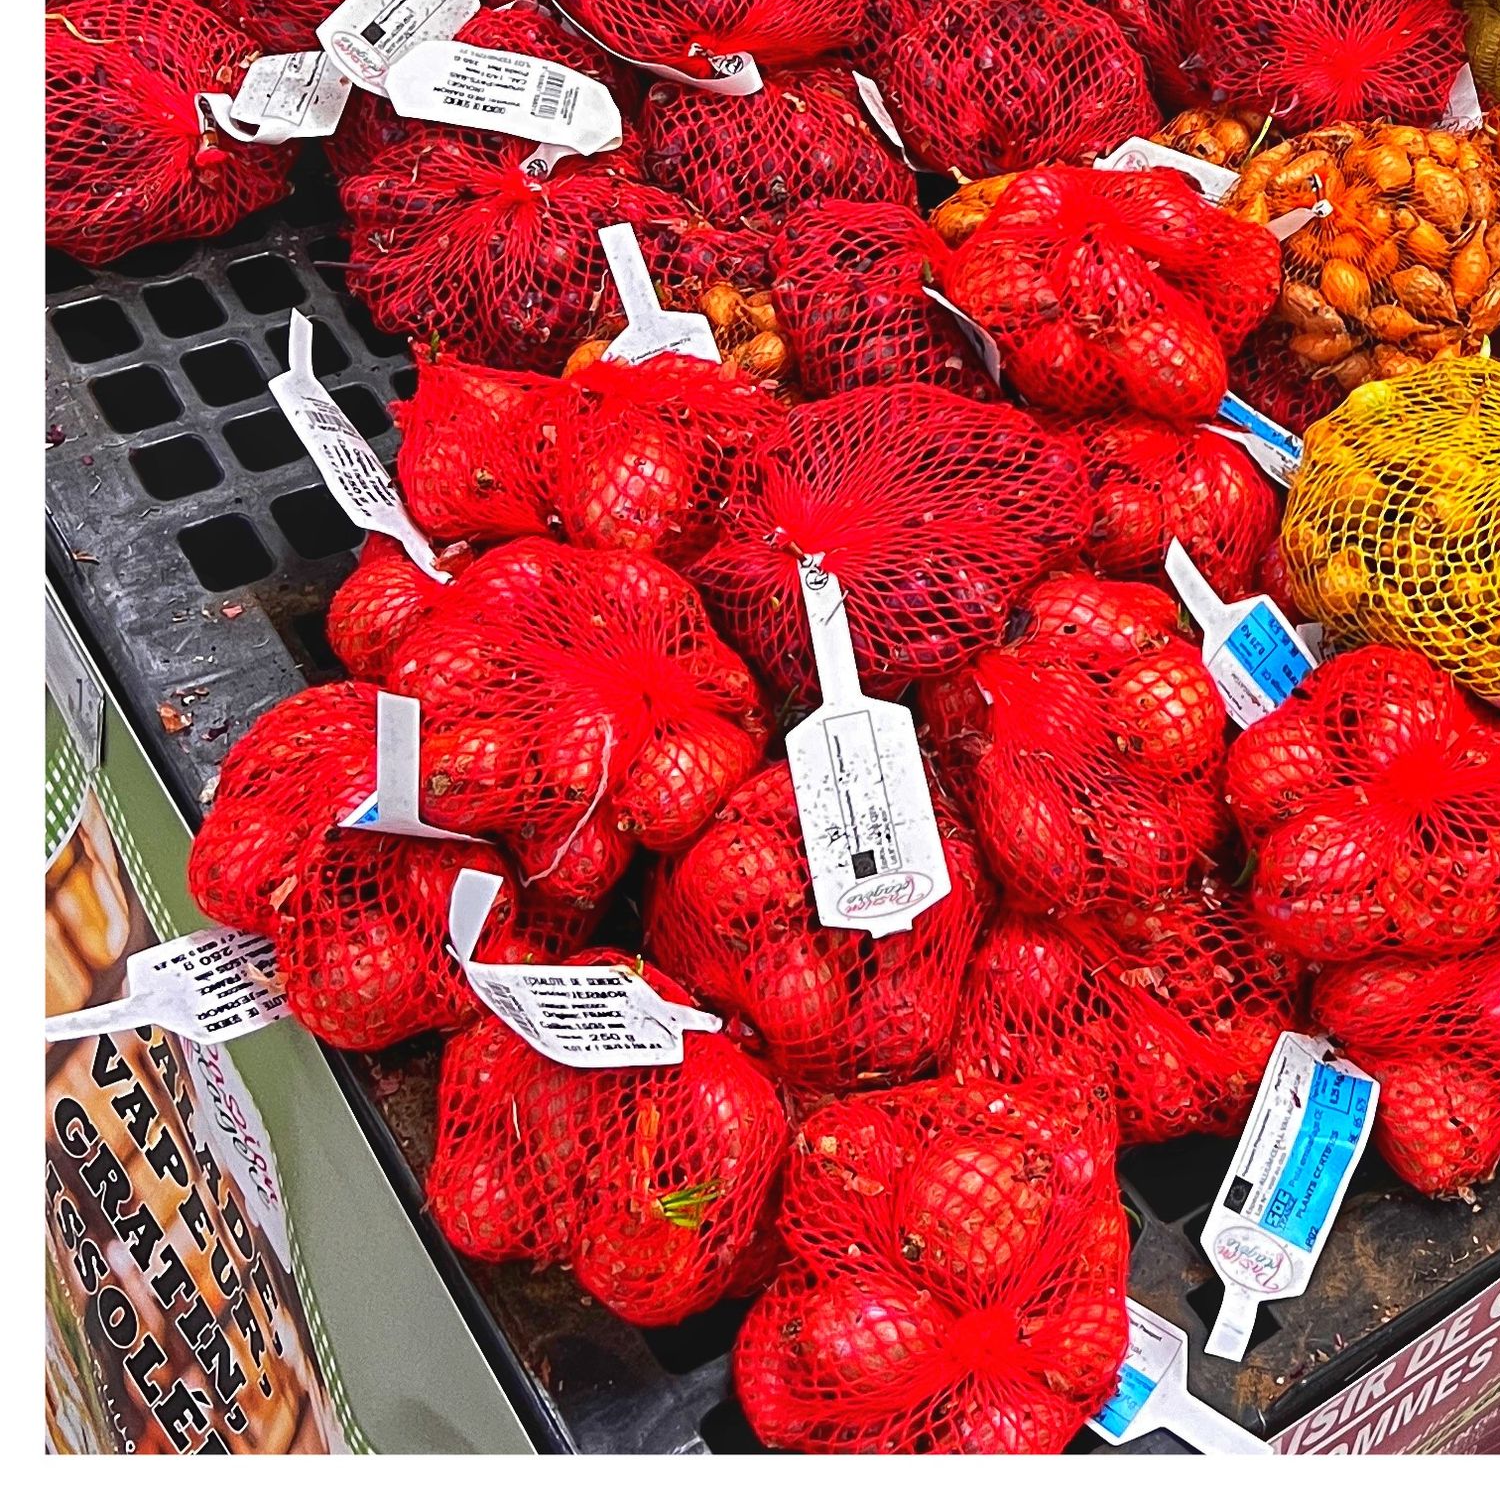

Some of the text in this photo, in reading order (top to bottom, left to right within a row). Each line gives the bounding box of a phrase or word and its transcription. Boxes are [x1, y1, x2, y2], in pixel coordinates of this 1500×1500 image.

[1295, 1176, 1319, 1220] PLANTS
[46, 1158, 229, 1455] ISSOLÉE
[53, 1095, 244, 1437] GRATIN,
[1321, 1337, 1497, 1455] OMMES
[1404, 1303, 1486, 1378] DE
